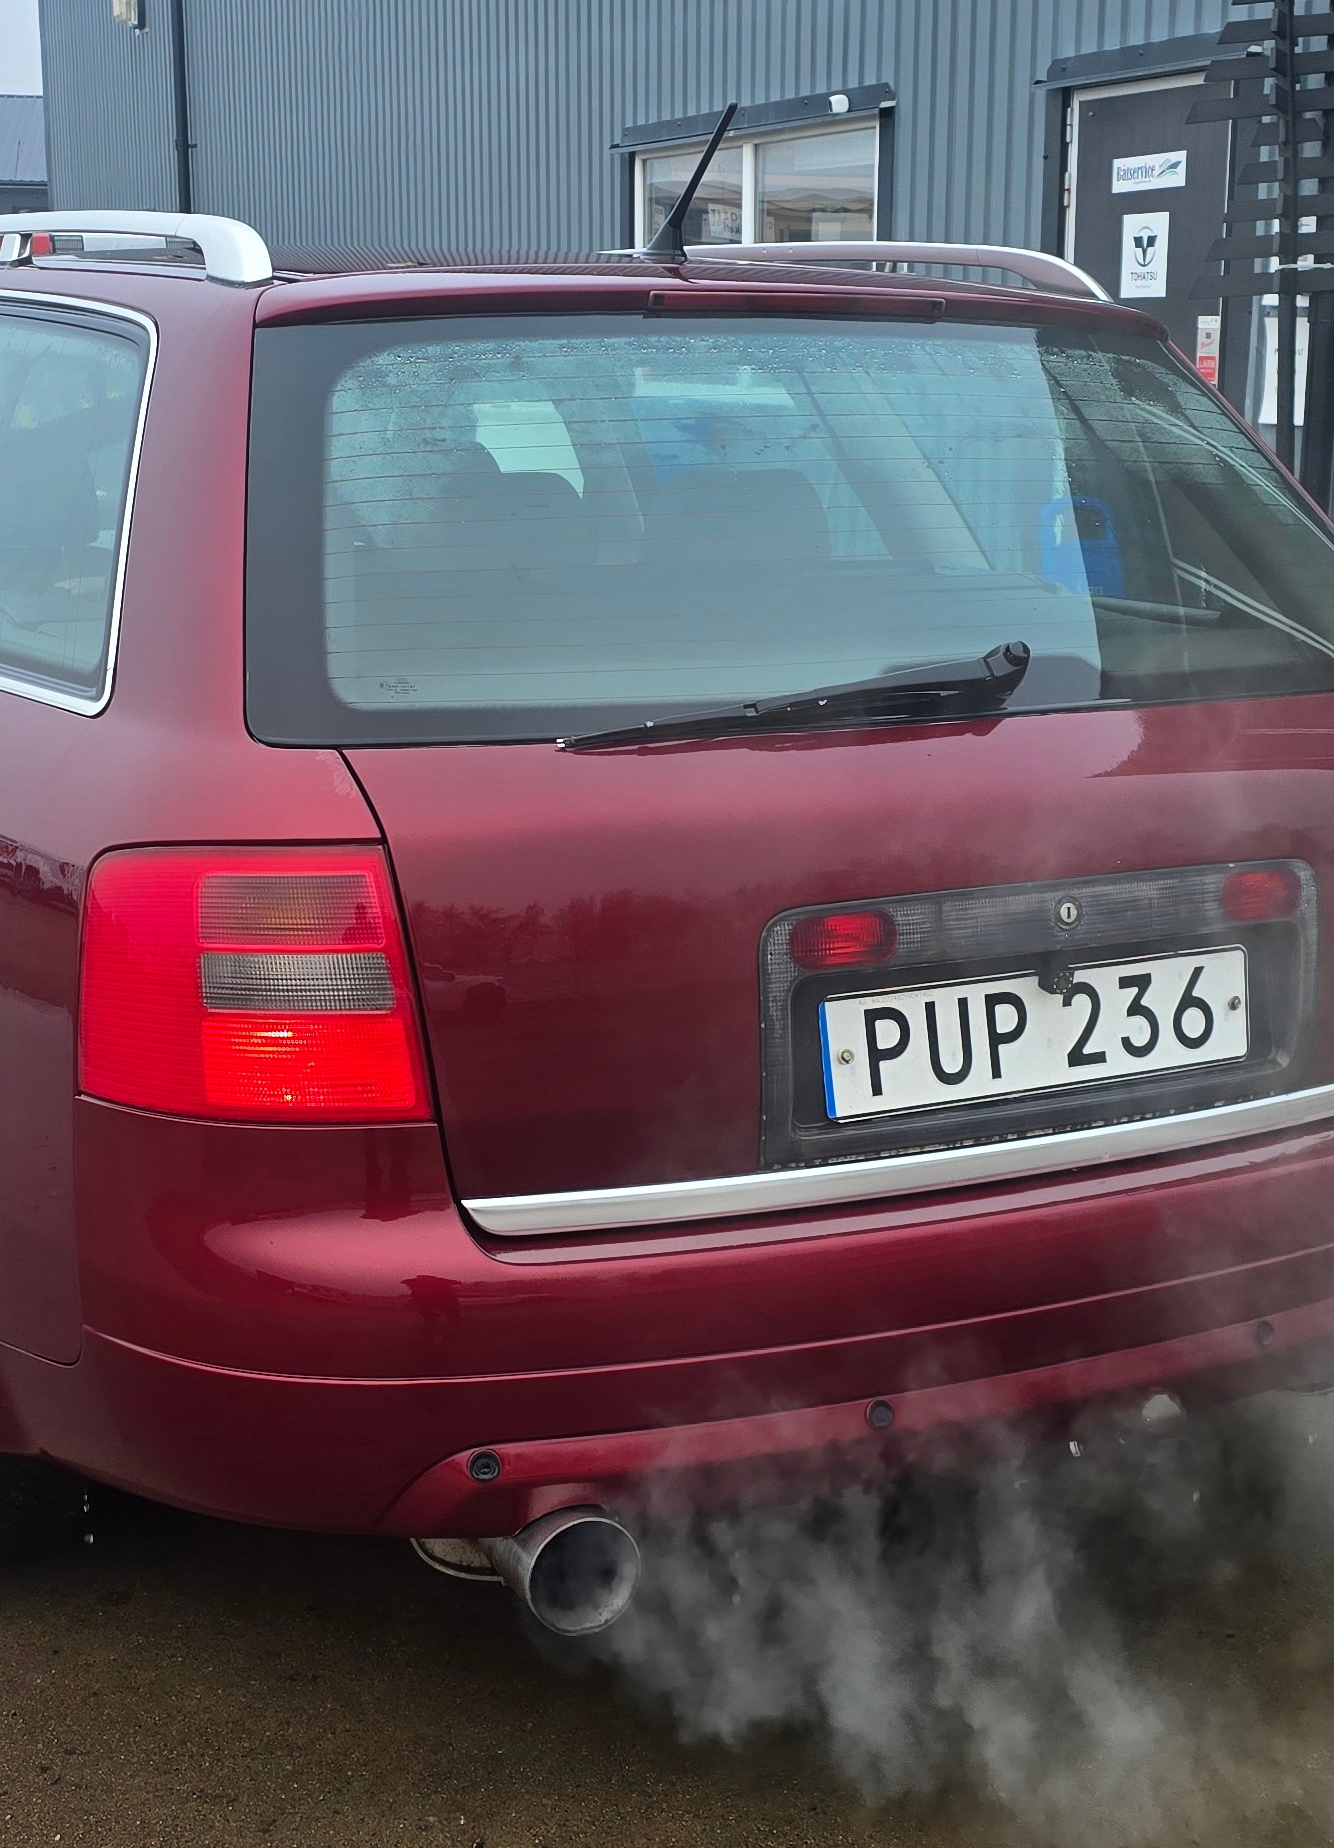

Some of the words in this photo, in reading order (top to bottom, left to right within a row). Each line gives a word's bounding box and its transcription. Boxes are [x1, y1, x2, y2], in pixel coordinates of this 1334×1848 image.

[1130, 271, 1158, 282] TOHATSU
[862, 991, 1029, 1098] PUP
[1061, 965, 1215, 1067] 236
